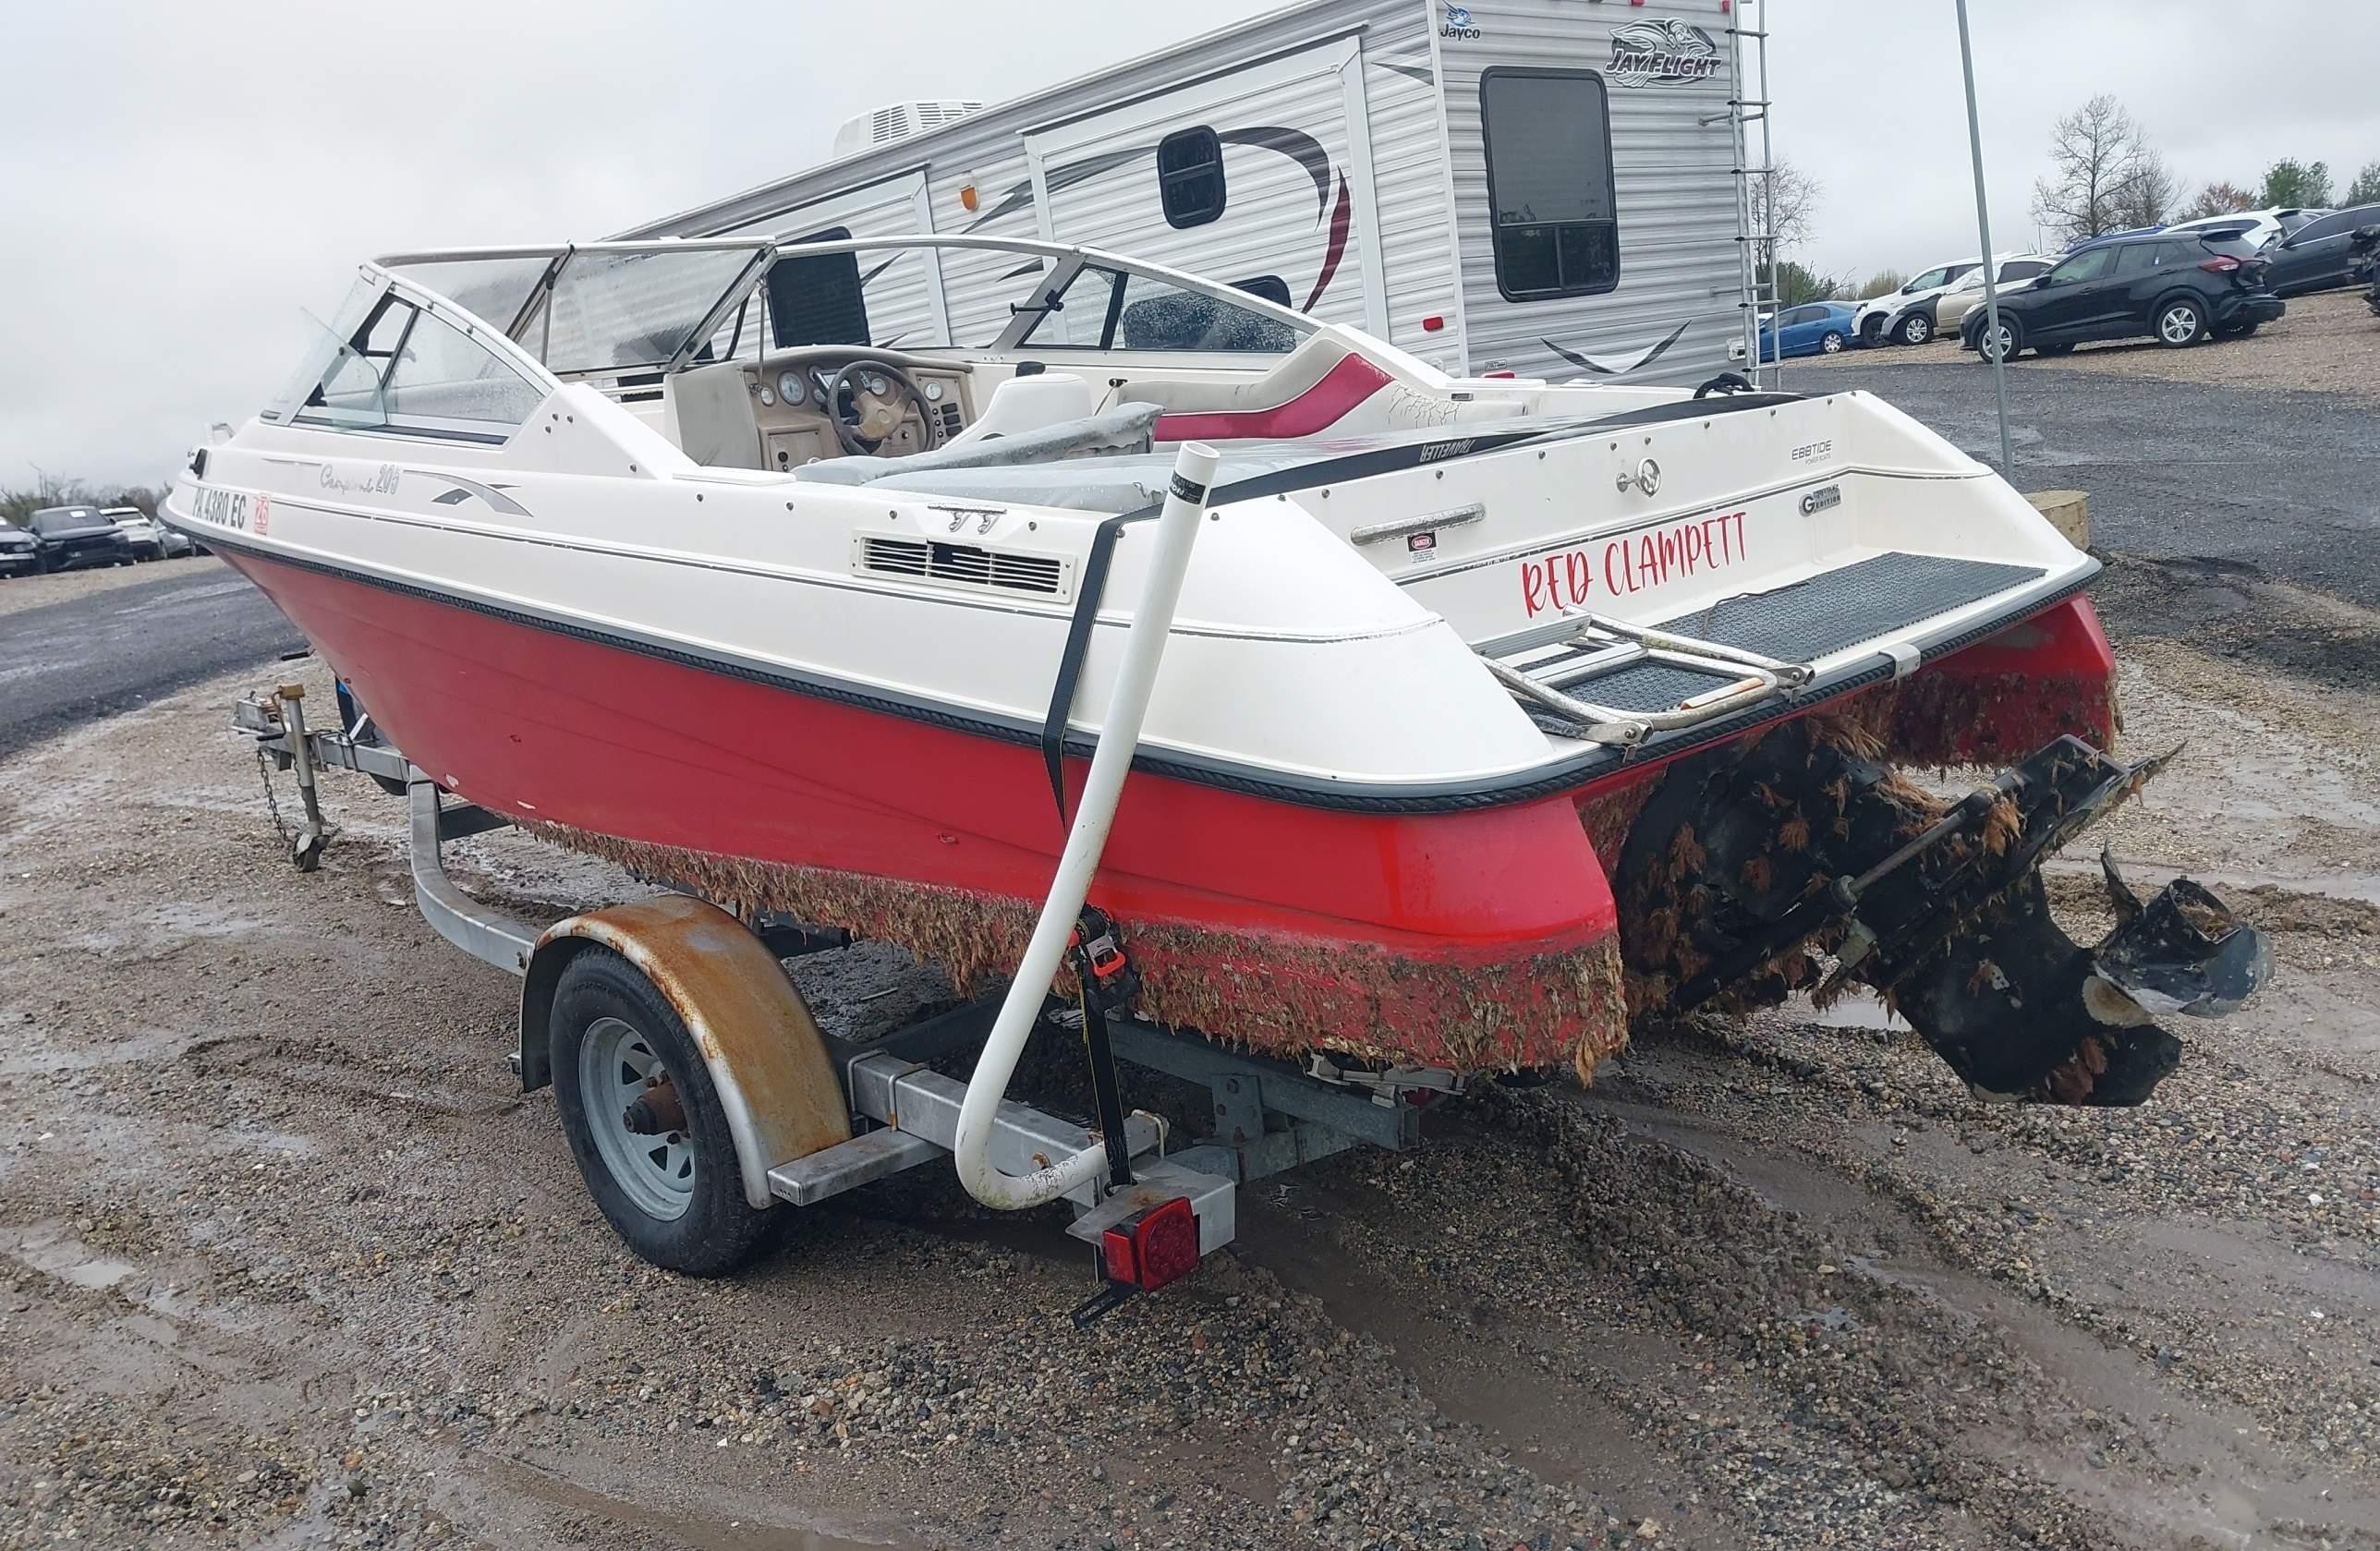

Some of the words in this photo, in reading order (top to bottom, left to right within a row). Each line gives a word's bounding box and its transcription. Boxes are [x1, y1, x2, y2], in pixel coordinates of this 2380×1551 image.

[1439, 23, 1480, 41] Jayco
[1419, 439, 1476, 462] TRAVELLER
[1791, 440, 1832, 460] EBBTIDE
[204, 489, 229, 525] 4380
[230, 493, 247, 529] EC
[1522, 551, 1594, 619] RED
[1604, 511, 1747, 597] CLAMPETT
